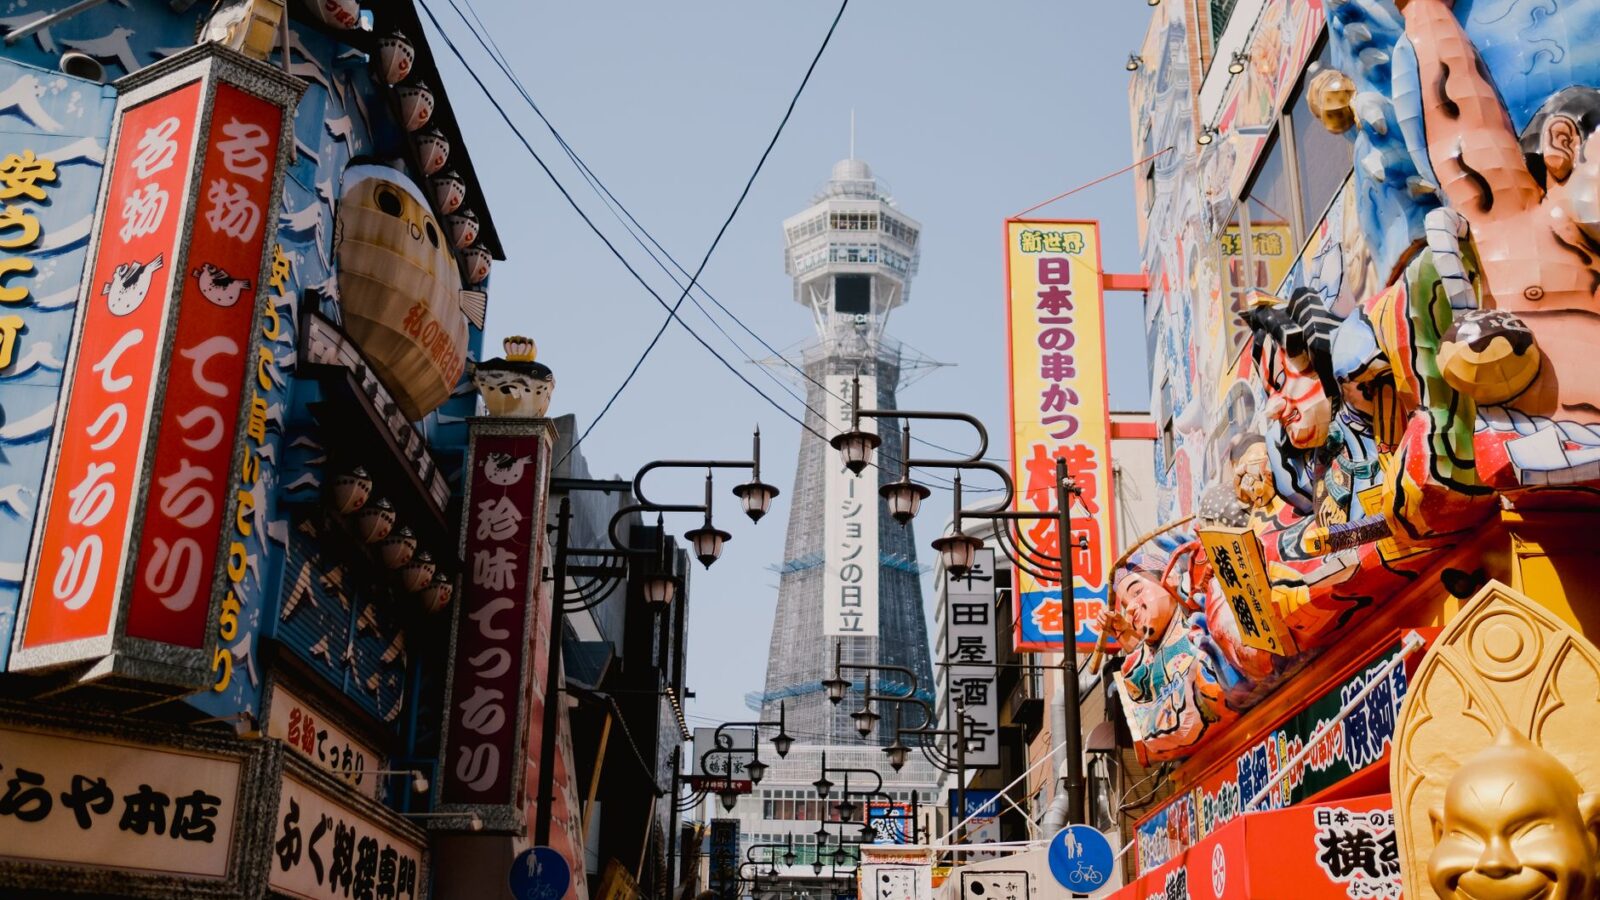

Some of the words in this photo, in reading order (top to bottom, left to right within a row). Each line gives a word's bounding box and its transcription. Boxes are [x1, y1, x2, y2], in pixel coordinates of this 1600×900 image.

[1020, 230, 1084, 254] 新世界
[1036, 257, 1079, 440] 日本一の串かつ
[1026, 444, 1102, 588] 横綱
[1035, 601, 1102, 633] 名門
[0, 763, 222, 843] らや本店
